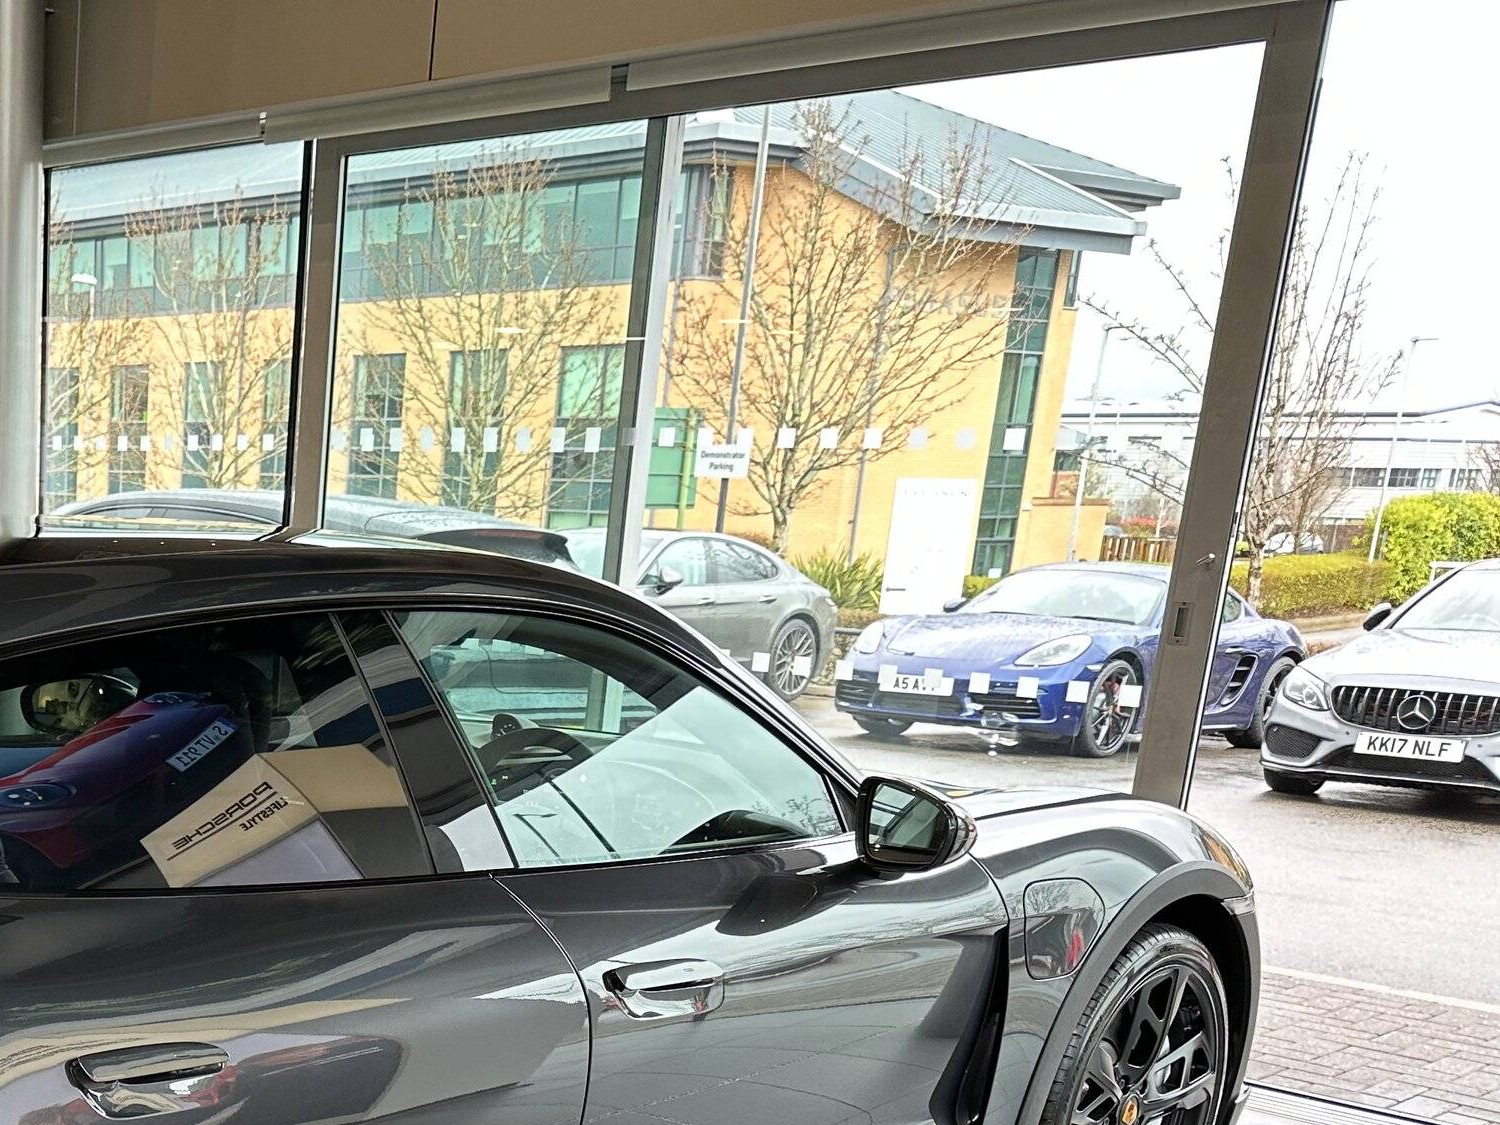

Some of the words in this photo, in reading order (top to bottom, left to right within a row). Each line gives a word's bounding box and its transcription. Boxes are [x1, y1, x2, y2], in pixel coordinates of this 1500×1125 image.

[701, 450, 746, 459] Demonstrator
[709, 462, 734, 472] Parking
[894, 677, 909, 689] A5
[1367, 736, 1408, 753] KK17
[1412, 740, 1452, 757] NLF
